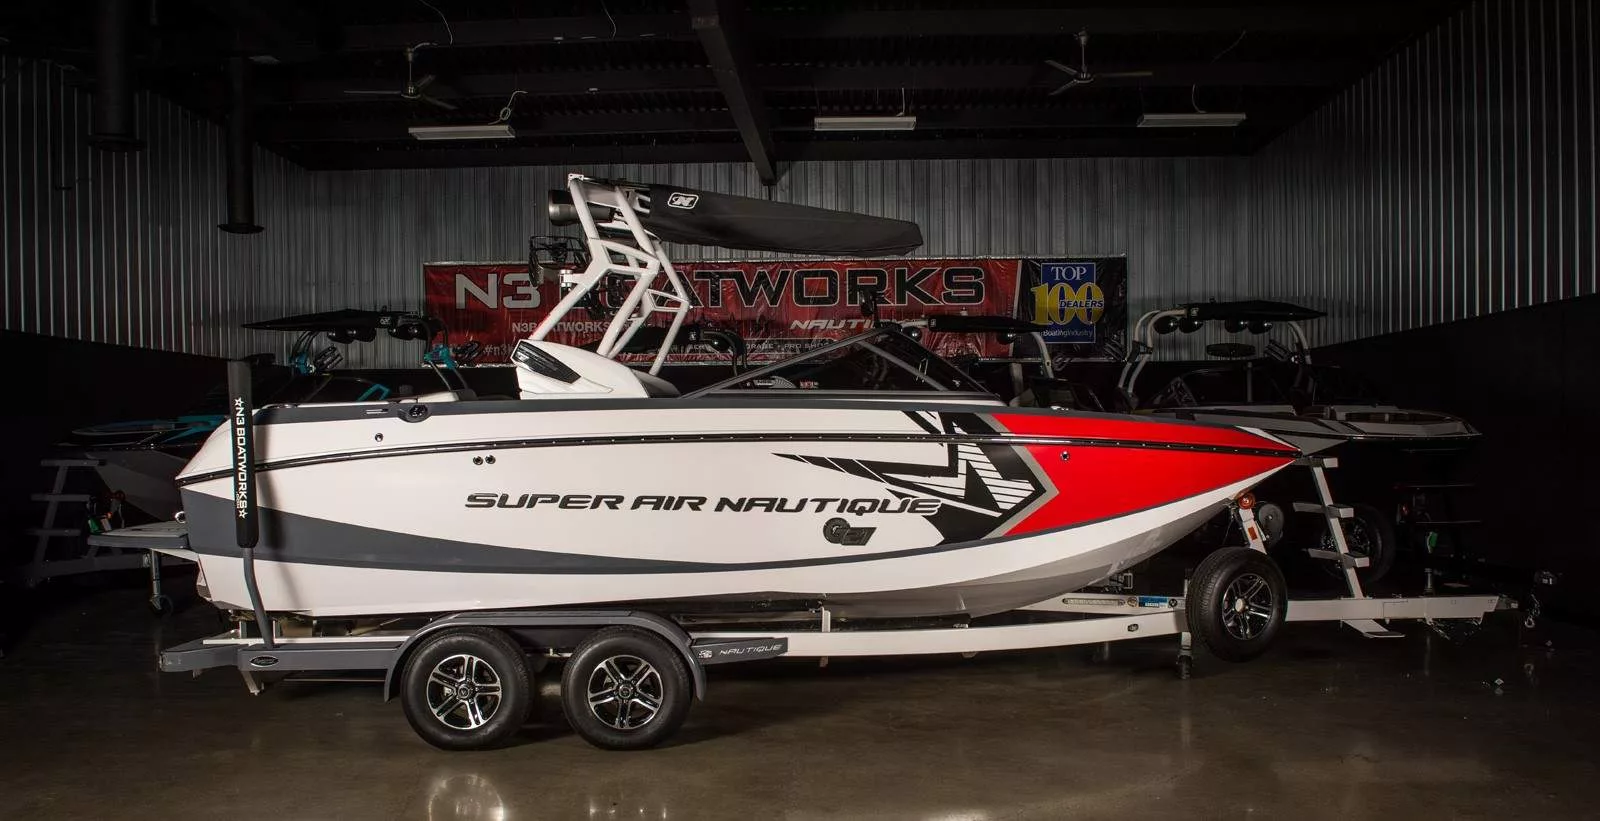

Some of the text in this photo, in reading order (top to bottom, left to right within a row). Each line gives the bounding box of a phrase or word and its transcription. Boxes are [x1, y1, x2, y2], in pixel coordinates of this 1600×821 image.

[1050, 266, 1087, 281] TOP
[455, 273, 541, 309] N3
[1030, 282, 1105, 325] 100
[1060, 300, 1104, 308] DEALERS
[790, 319, 898, 329] NAUTI
[235, 406, 246, 425] N3
[236, 427, 248, 508] BOATWORKS
[465, 493, 942, 516] SUPER AIR NAUTIQUE
[719, 644, 783, 655] NAUTIQUE
